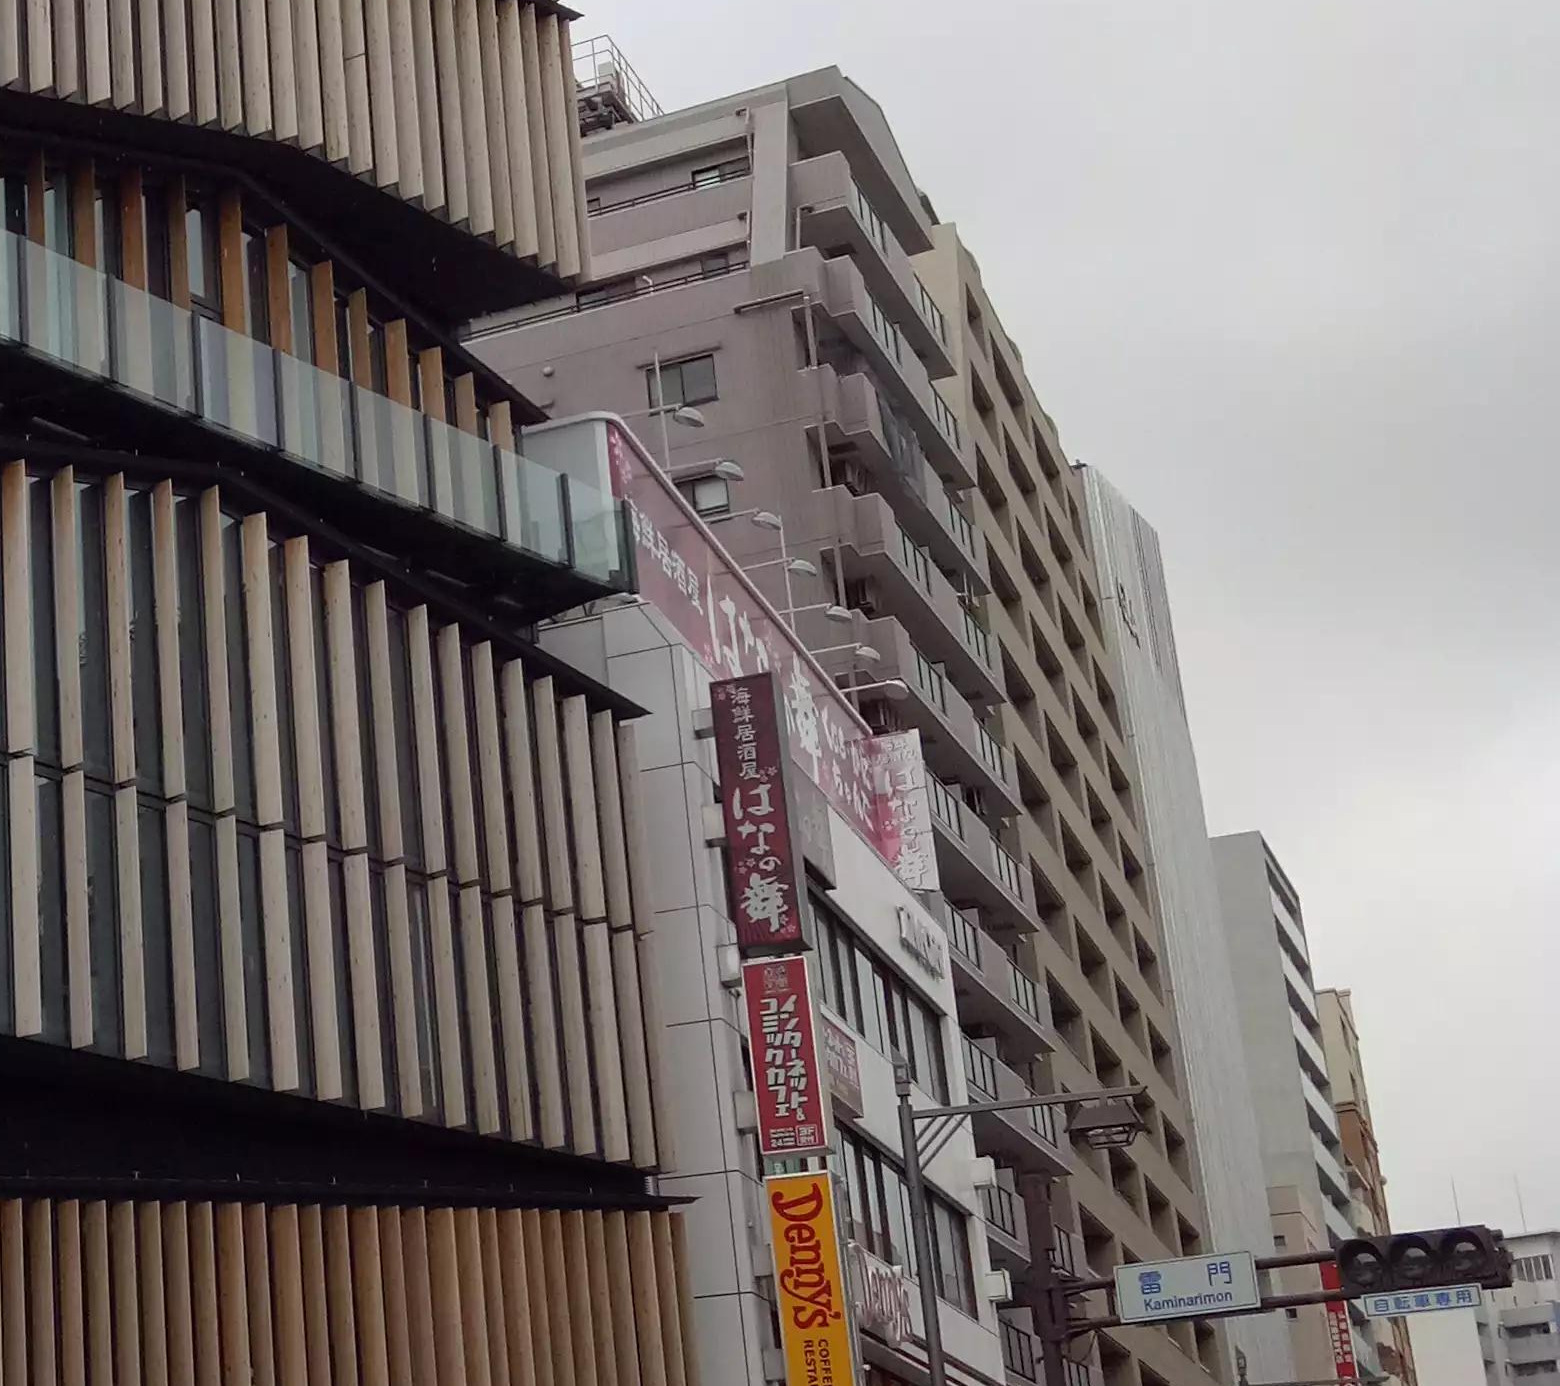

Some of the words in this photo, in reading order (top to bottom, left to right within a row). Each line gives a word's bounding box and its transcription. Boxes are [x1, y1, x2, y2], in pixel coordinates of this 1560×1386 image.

[730, 685, 760, 780] 海鮮居酒屋
[732, 783, 789, 933] はなの舞
[759, 998, 790, 1117] コミックカフェ
[779, 994, 809, 1121] インターネット&
[771, 1183, 841, 1329] Denny's
[1139, 1261, 1233, 1295] 雷門
[1144, 1291, 1233, 1312] Kaminarimon
[1373, 1286, 1474, 1312] 自転車専用
